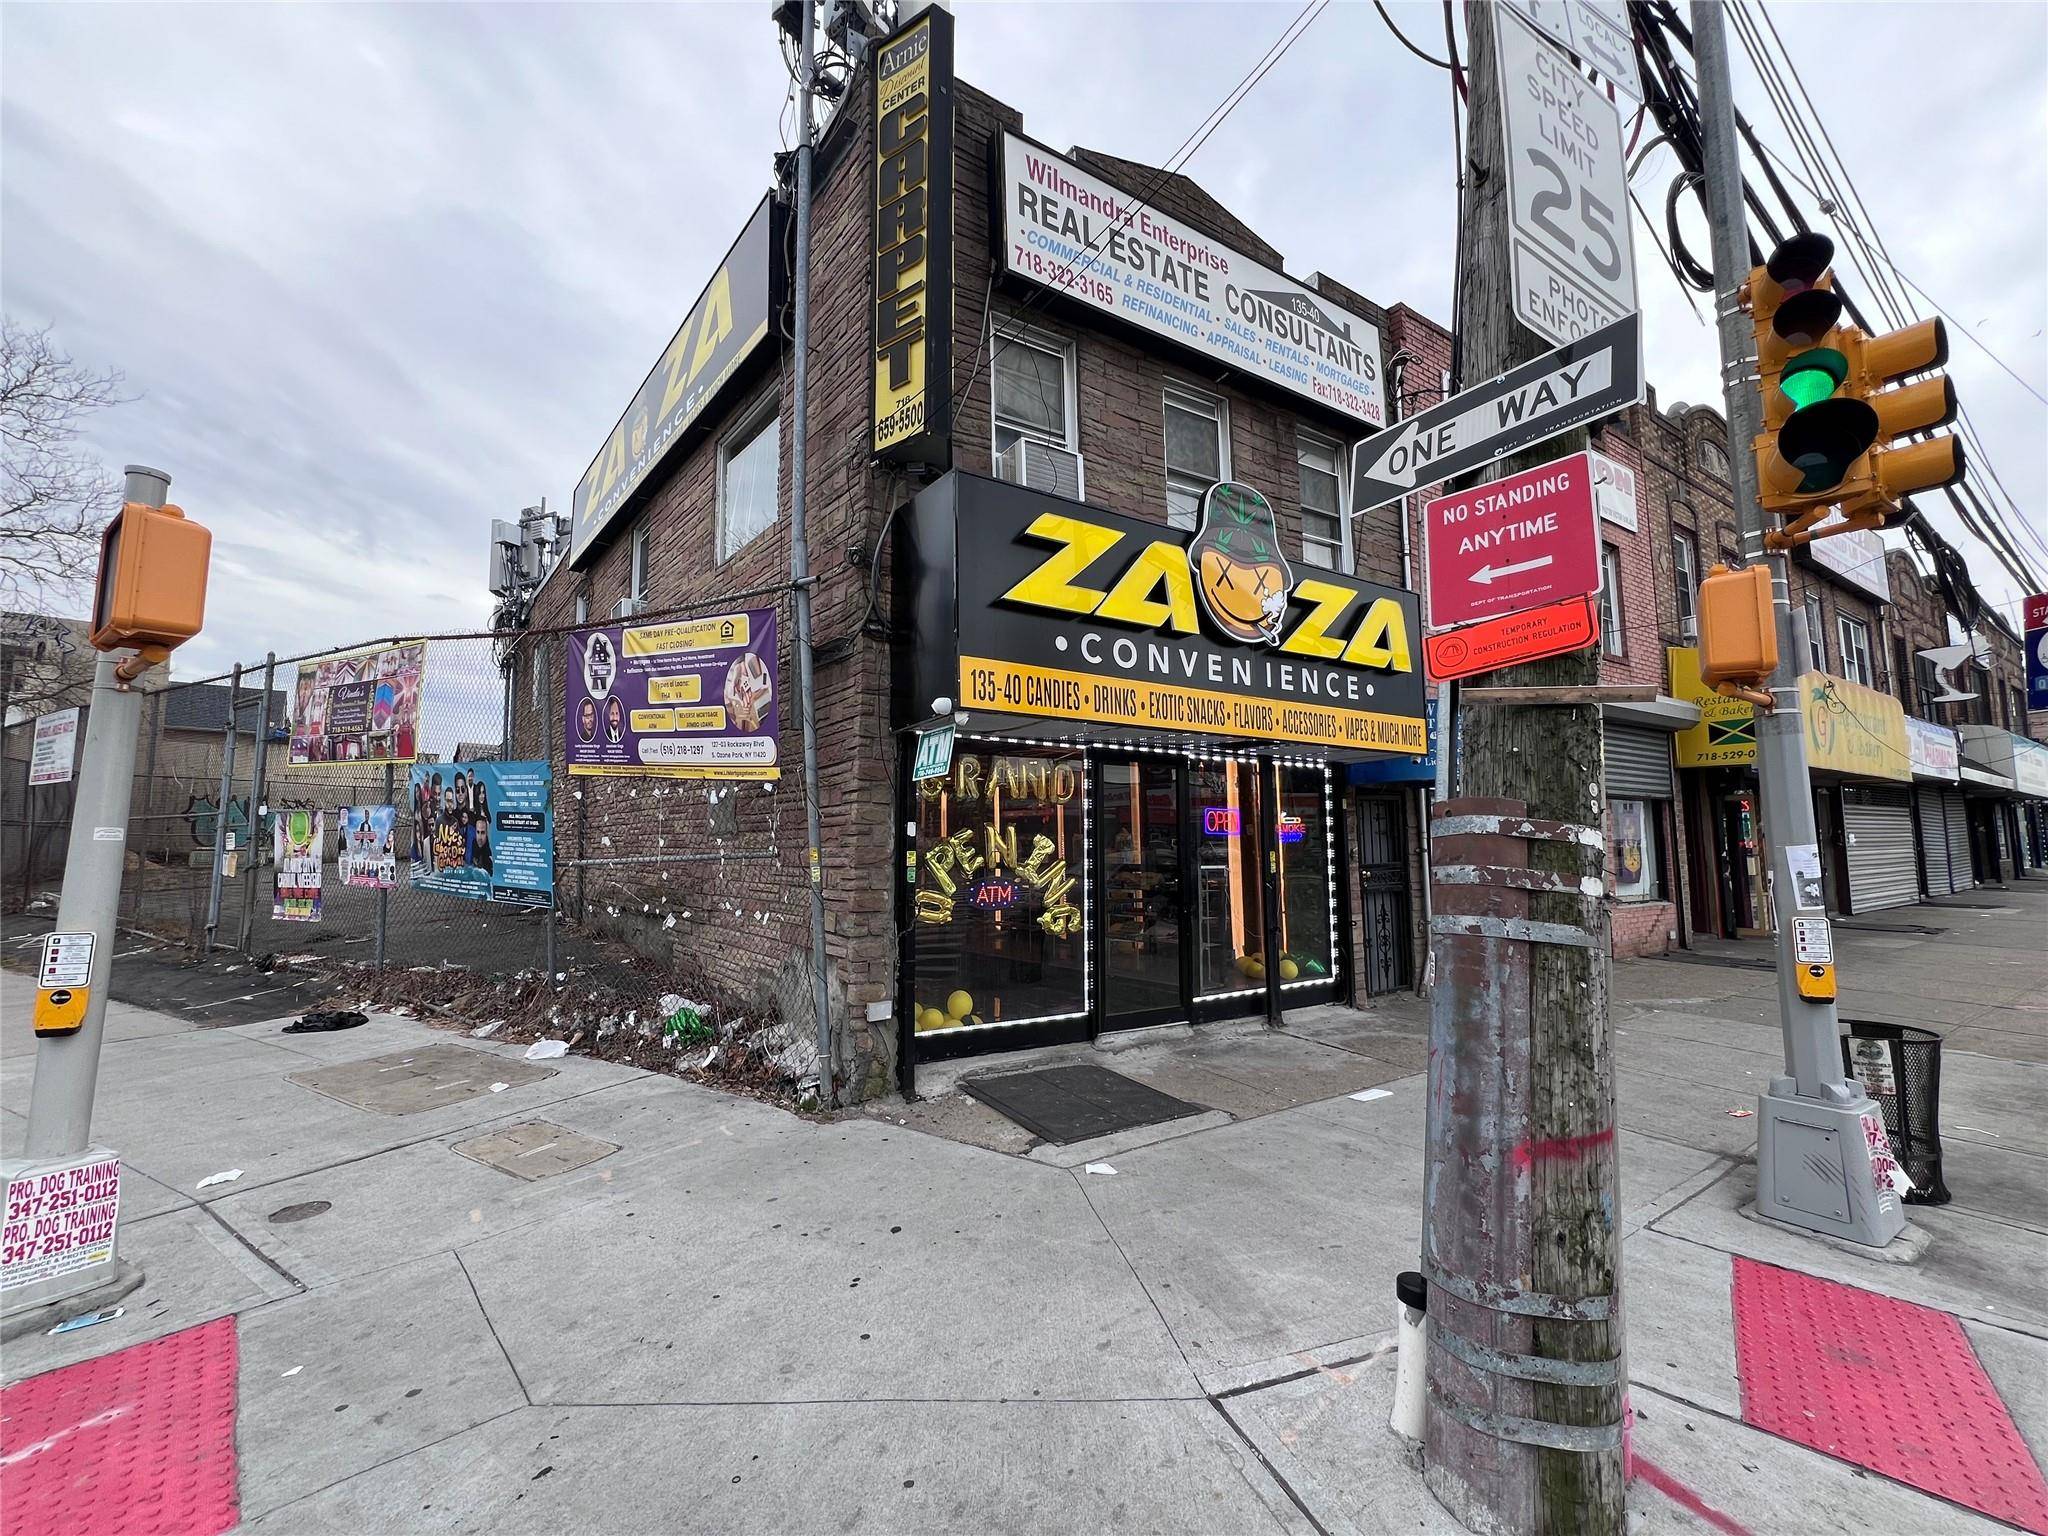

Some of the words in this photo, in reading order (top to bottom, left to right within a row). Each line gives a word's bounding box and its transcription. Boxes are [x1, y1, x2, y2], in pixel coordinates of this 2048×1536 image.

[1577, 7, 1622, 51] LOCAL
[882, 75, 926, 111] CENTER
[1534, 52, 1584, 107] CITY
[1526, 74, 1599, 151] SPEED
[1538, 112, 1596, 178] LIMIT
[1024, 154, 1135, 229] Wilmandra
[1140, 210, 1230, 276] Enterprise
[1526, 148, 1621, 281] 25
[878, 92, 927, 392] CARPET
[1017, 181, 1100, 253] REAL
[1108, 226, 1210, 303] ESTATE
[1224, 283, 1376, 382] CONSULTANTS
[1013, 244, 1114, 306] 718-322-3165
[1121, 293, 1199, 339] REFINANCING
[1205, 331, 1262, 367] APPRAISAL
[1267, 359, 1308, 385] LEASING
[1026, 229, 1121, 285] COMMERCIAL
[1124, 273, 1133, 287] &
[1136, 276, 1213, 325] RESIDENTIAL
[1224, 316, 1257, 343] SALES
[1264, 337, 1311, 368] RENTALS
[1315, 361, 1370, 397] MORTGAGES
[1290, 296, 1321, 323] 135-40
[1528, 288, 1589, 341] ENFO
[877, 400, 924, 443] 659-5500
[1388, 421, 1457, 476] ONE
[1496, 360, 1592, 429] WAY
[1544, 397, 1623, 432] TRANSPORTATION
[1442, 503, 1468, 525] NO
[1474, 473, 1570, 516] STANDING
[1458, 512, 1558, 555] ANYTIME
[1000, 511, 1201, 635] ZA
[1278, 578, 1413, 673] ZA
[1470, 599, 1486, 607] DEPT
[1495, 584, 1553, 603] TRANSPORTATION
[656, 642, 668, 650] FAST
[664, 623, 716, 637] PRE-QUALIFICATION
[1473, 635, 1529, 655] CONSTRUCTION
[1532, 622, 1582, 641] REGULATION
[1501, 616, 1548, 637] TEMPORARY
[1080, 632, 1360, 700] CONVENIENCE
[970, 667, 1022, 705] 135-40
[1025, 675, 1081, 711] CANDIES
[1093, 685, 1137, 718] DRINKS
[1148, 690, 1185, 721] EXOTIC
[1186, 695, 1226, 727] SNACKS
[1233, 702, 1273, 733] FLAVORS
[1282, 708, 1338, 739] ACCESSORIES
[1344, 715, 1369, 742] VAPES
[1377, 719, 1400, 745] MUCH
[1400, 723, 1422, 748] MORE
[1695, 696, 1740, 709] Restau
[1719, 703, 1754, 716] Baker
[916, 731, 954, 769] ATM
[1206, 810, 1240, 832] OPEN
[976, 885, 1012, 903] ATM
[8, 1179, 36, 1202] PRO.
[39, 1172, 65, 1195] DOG
[69, 1159, 120, 1188] TRAINING
[8, 1179, 118, 1220] 347-251-0112
[1, 1220, 113, 1264] 347-251-0112
[2, 1222, 30, 1246] PRO.
[34, 1215, 60, 1238] DOG
[64, 1202, 116, 1231] TRAINING
[61, 1243, 111, 1263] PROTECTION
[66, 1238, 113, 1255] EXPERIENCE
